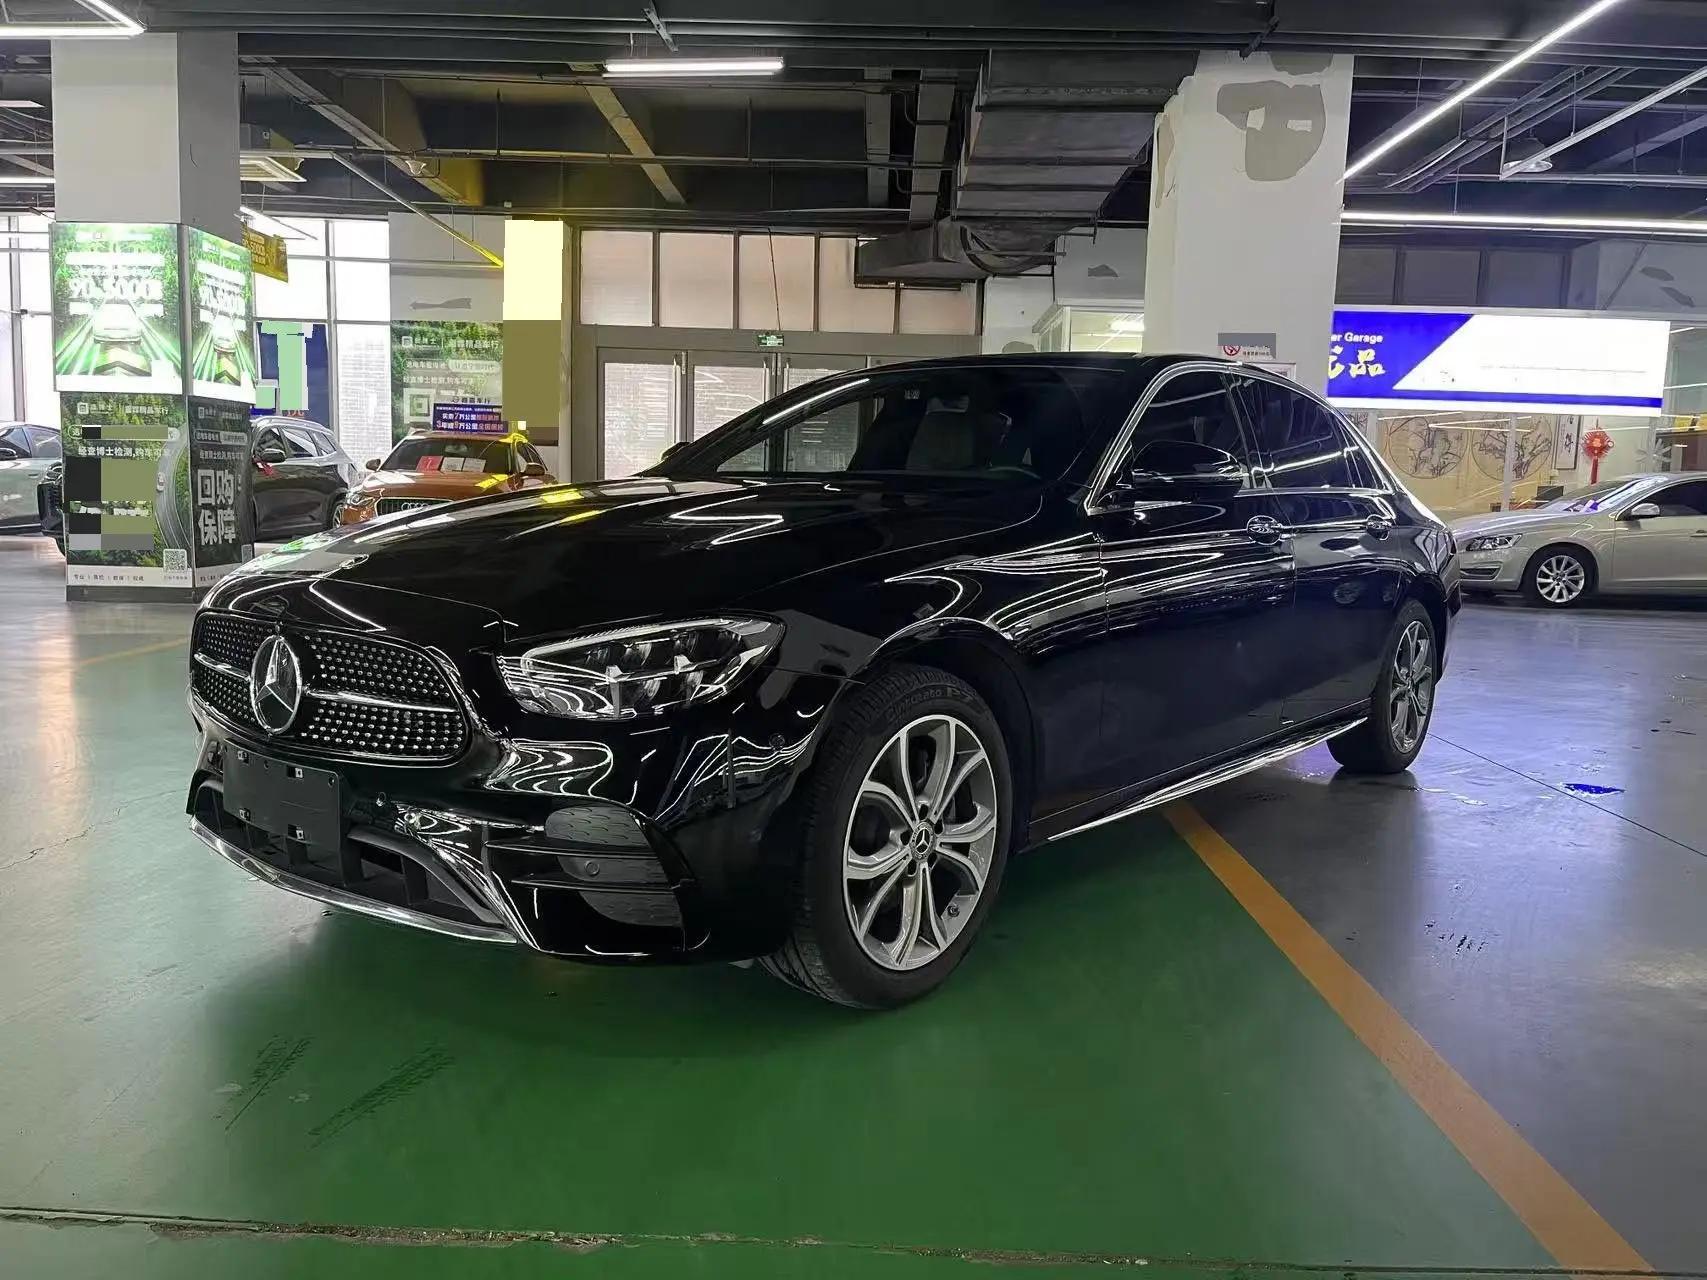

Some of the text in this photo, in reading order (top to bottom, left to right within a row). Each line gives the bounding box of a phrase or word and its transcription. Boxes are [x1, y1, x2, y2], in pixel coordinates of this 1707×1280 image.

[1344, 332, 1383, 344] Garage
[198, 469, 235, 506] 回购
[198, 508, 236, 545] 保障
